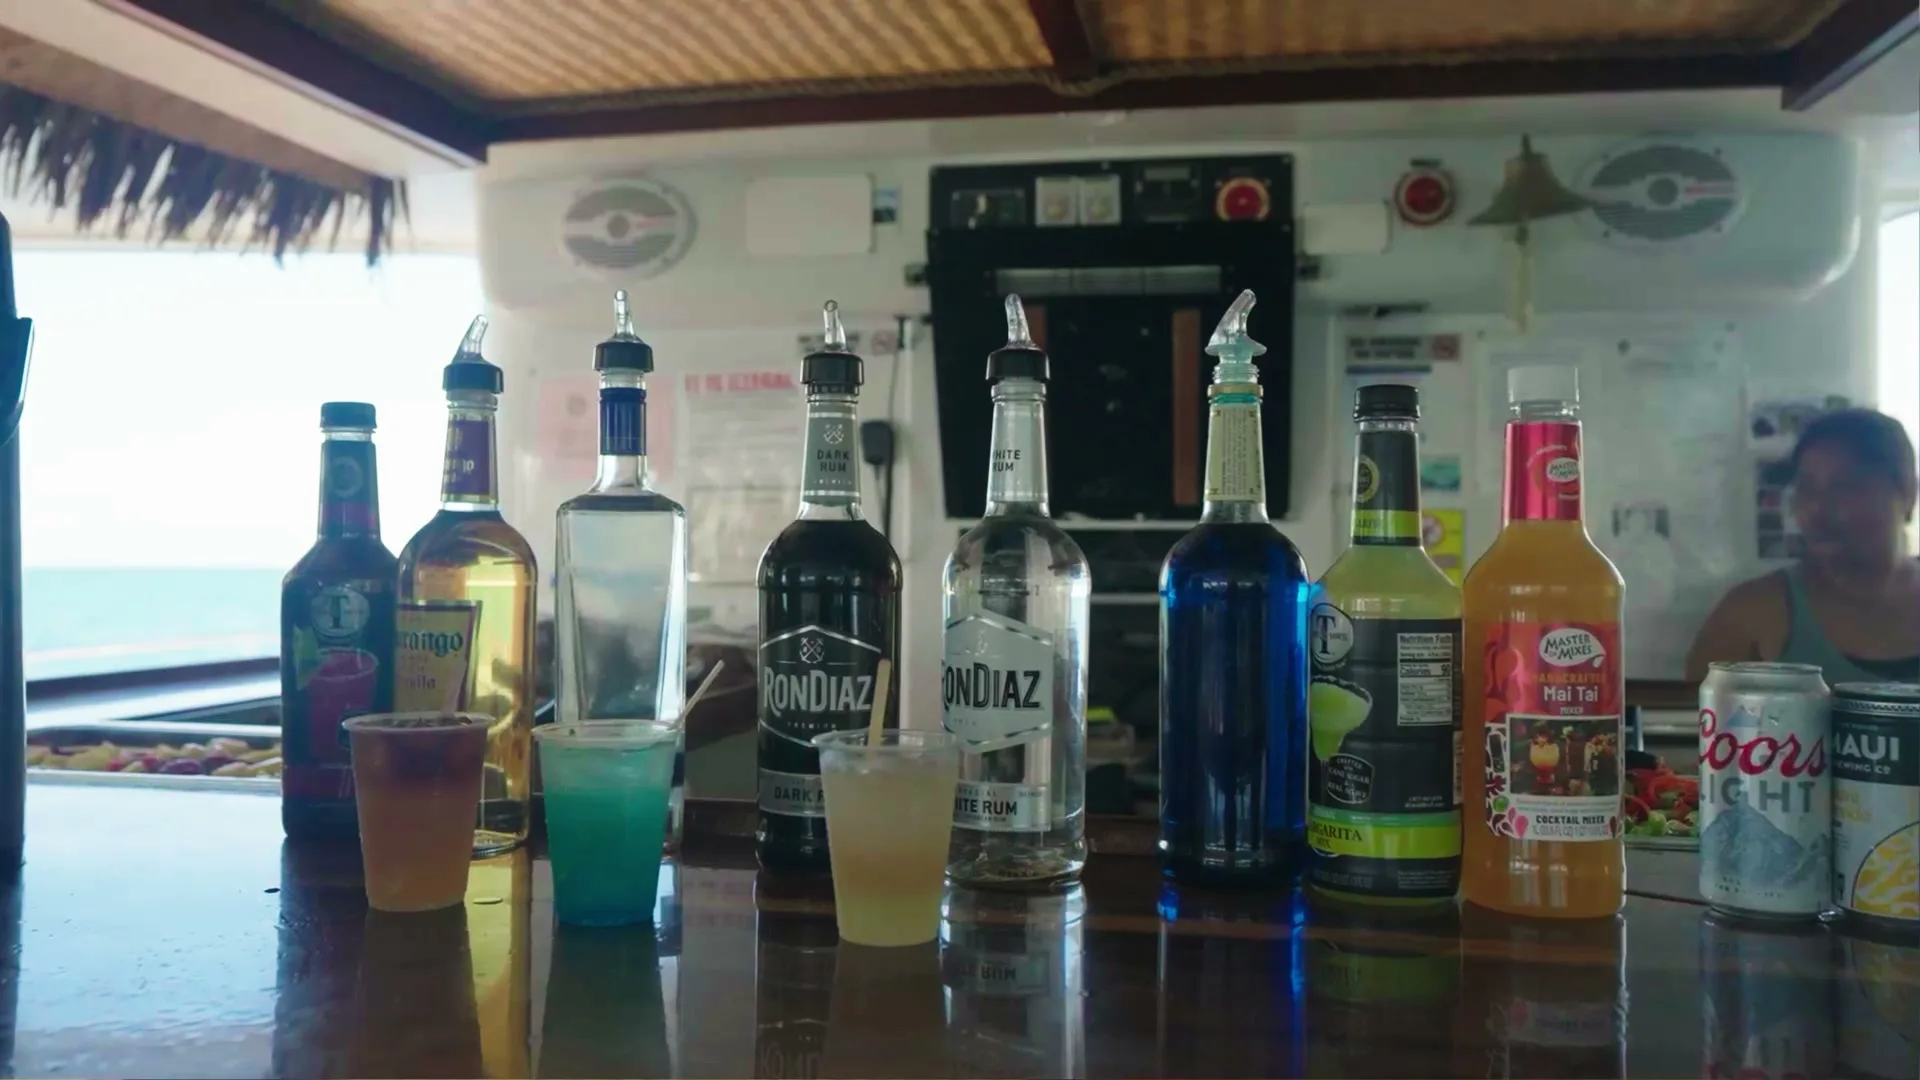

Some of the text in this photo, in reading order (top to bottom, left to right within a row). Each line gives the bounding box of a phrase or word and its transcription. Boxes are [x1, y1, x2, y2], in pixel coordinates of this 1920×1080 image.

[817, 450, 849, 460] DARK
[993, 449, 1021, 460] HITE
[820, 461, 846, 472] RUM
[402, 631, 464, 658] rango
[1544, 634, 1591, 654] MASTER
[1557, 645, 1592, 660] MIXES
[1543, 686, 1598, 702] Mai Tai
[774, 786, 813, 802] DARK
[1701, 774, 1816, 813] IGHT
[955, 797, 1018, 816] ITE RUM
[1536, 814, 1580, 825] COCKTAIL
